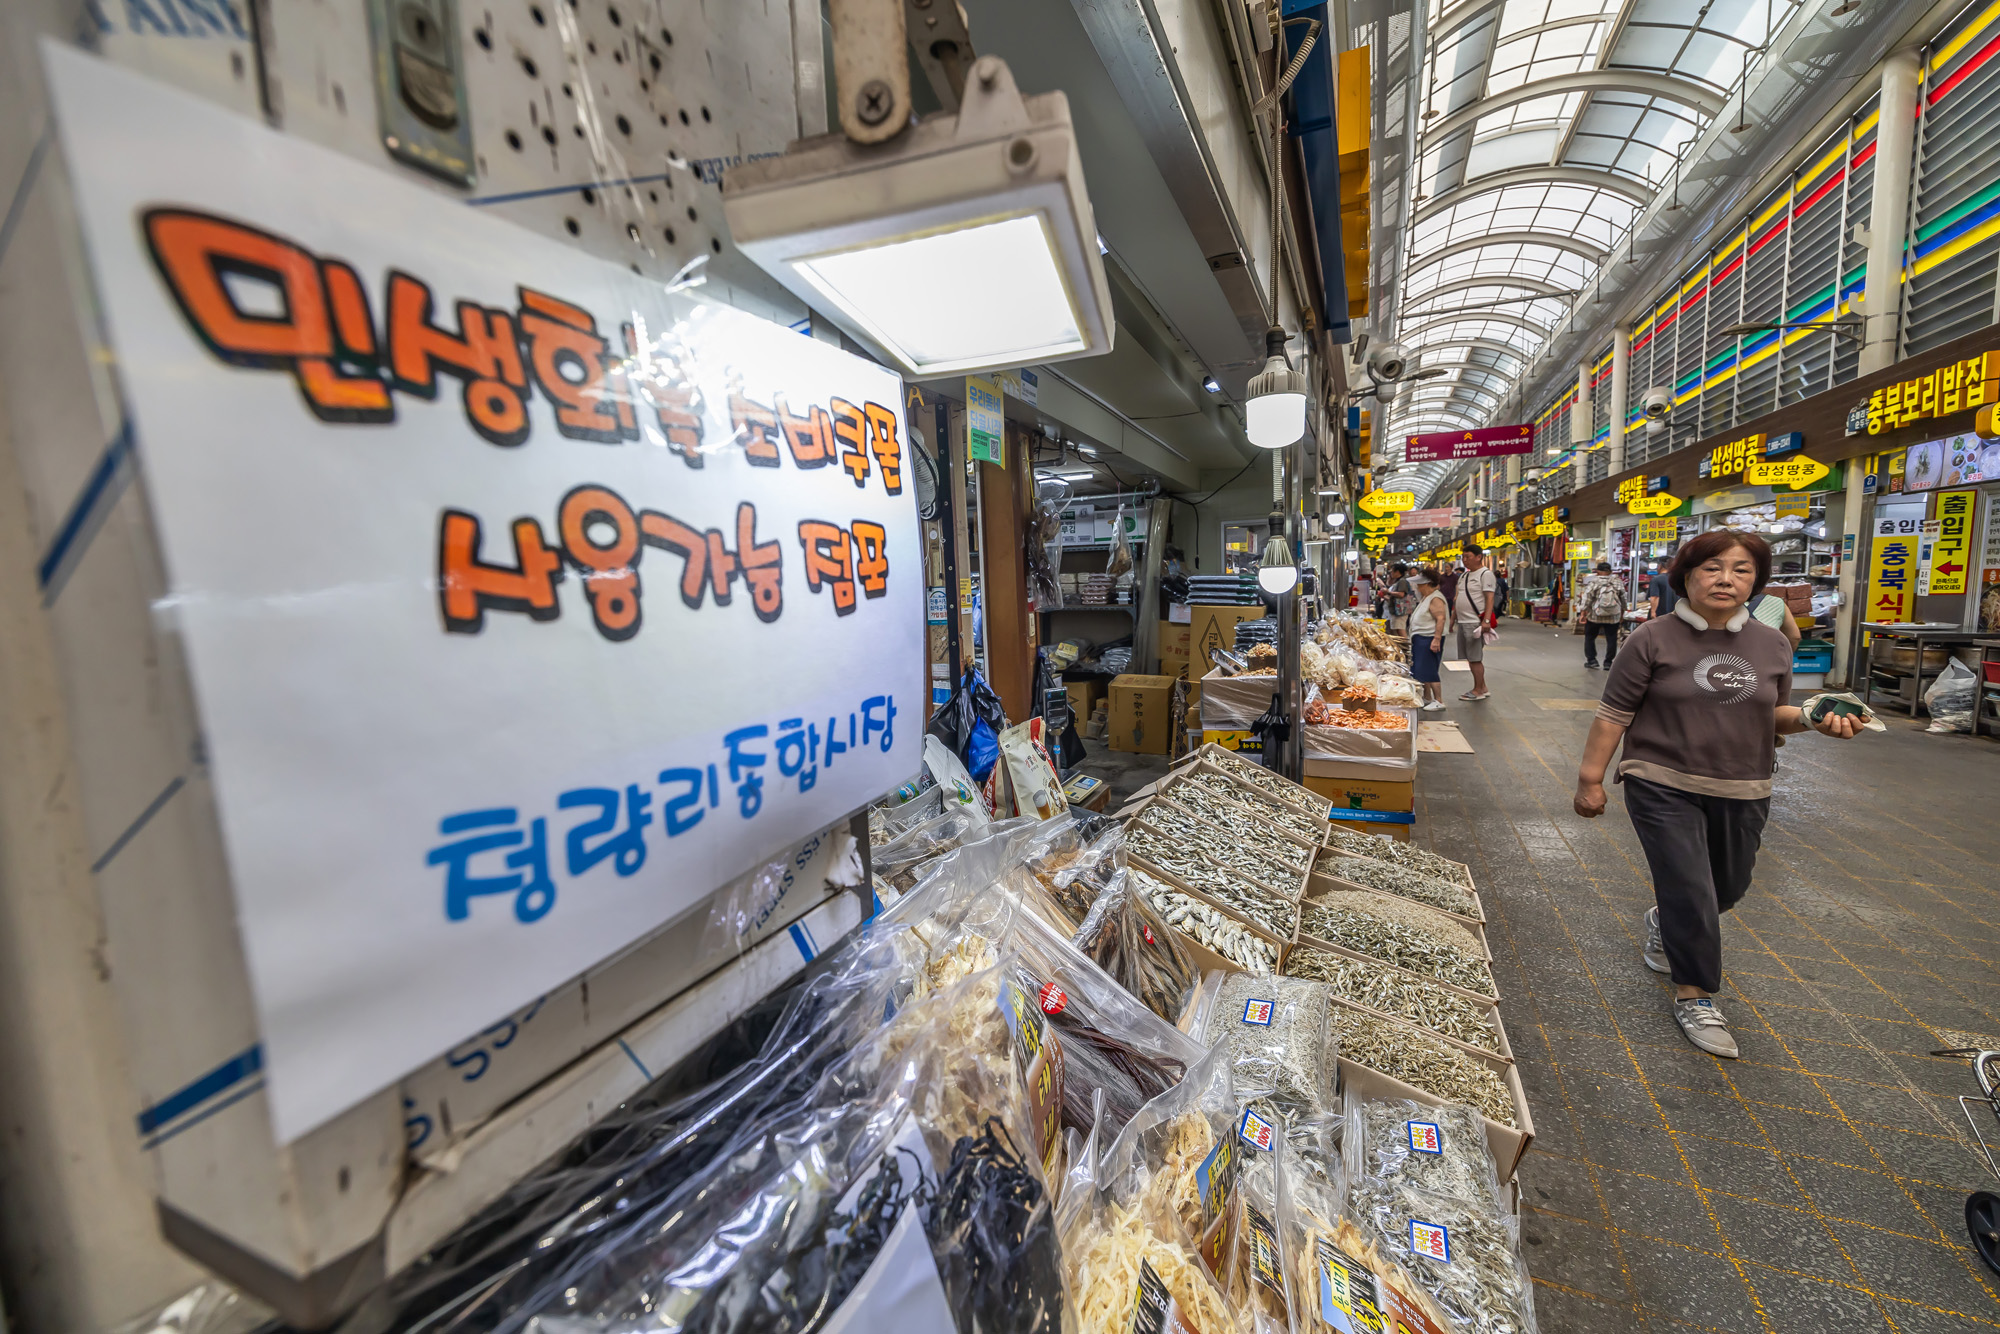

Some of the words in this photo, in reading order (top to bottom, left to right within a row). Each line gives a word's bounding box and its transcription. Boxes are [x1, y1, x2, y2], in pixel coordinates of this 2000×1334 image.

[970, 386, 1000, 414] 우리동네
[1867, 352, 1988, 435] 충북보리밥집
[970, 410, 1001, 437] 단골시장
[1711, 434, 1759, 478] 삼성땅콩
[1757, 463, 1816, 476] 삼성땅콩
[1633, 498, 1672, 508] 성일식품
[1648, 519, 1675, 529] 제분소
[1939, 495, 1967, 556] 출입구
[440, 484, 783, 641] 사용가능
[799, 519, 888, 616] 점포
[1875, 542, 1909, 625] 충북식
[1247, 1003, 1260, 1020] 국내산
[1258, 1004, 1270, 1021] 100%
[1245, 1116, 1260, 1139] 국내산
[1257, 1124, 1271, 1147] 100%
[1412, 1126, 1425, 1148] 국내산
[1424, 1127, 1437, 1149] 100%
[1414, 1227, 1430, 1252] 국내산
[1429, 1230, 1444, 1256] 100%
[1333, 1265, 1350, 1308] 용대리
